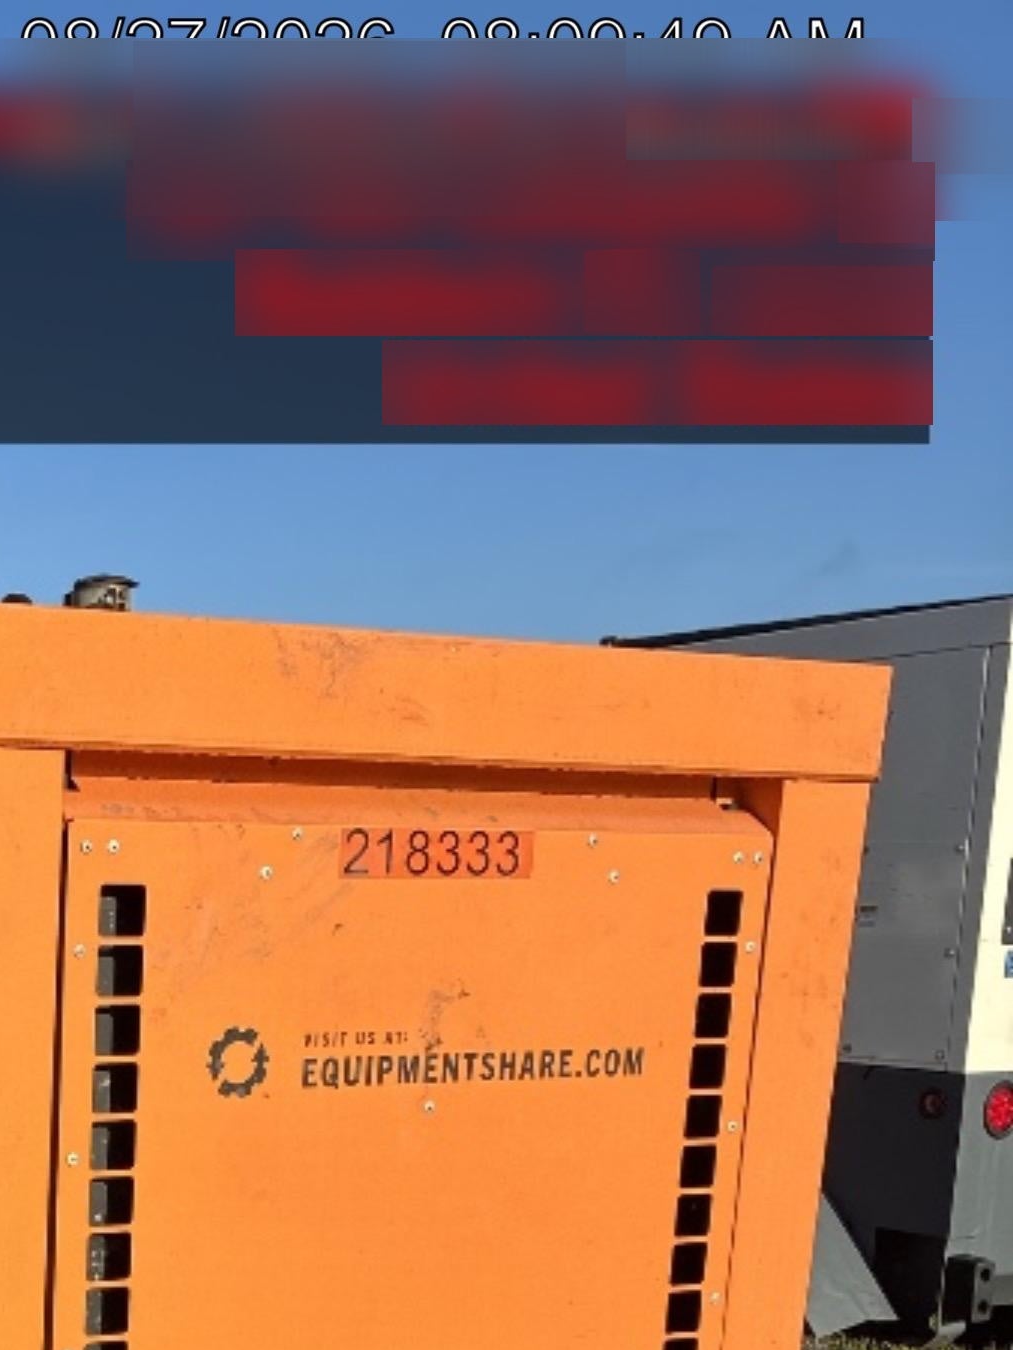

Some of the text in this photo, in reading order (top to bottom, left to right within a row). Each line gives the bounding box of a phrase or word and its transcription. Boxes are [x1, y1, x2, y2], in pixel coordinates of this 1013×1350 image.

[343, 827, 519, 876] 218333
[304, 1031, 408, 1048] VISIT US AT:
[301, 1047, 645, 1089] EQUIPMENTSHARE.COM
